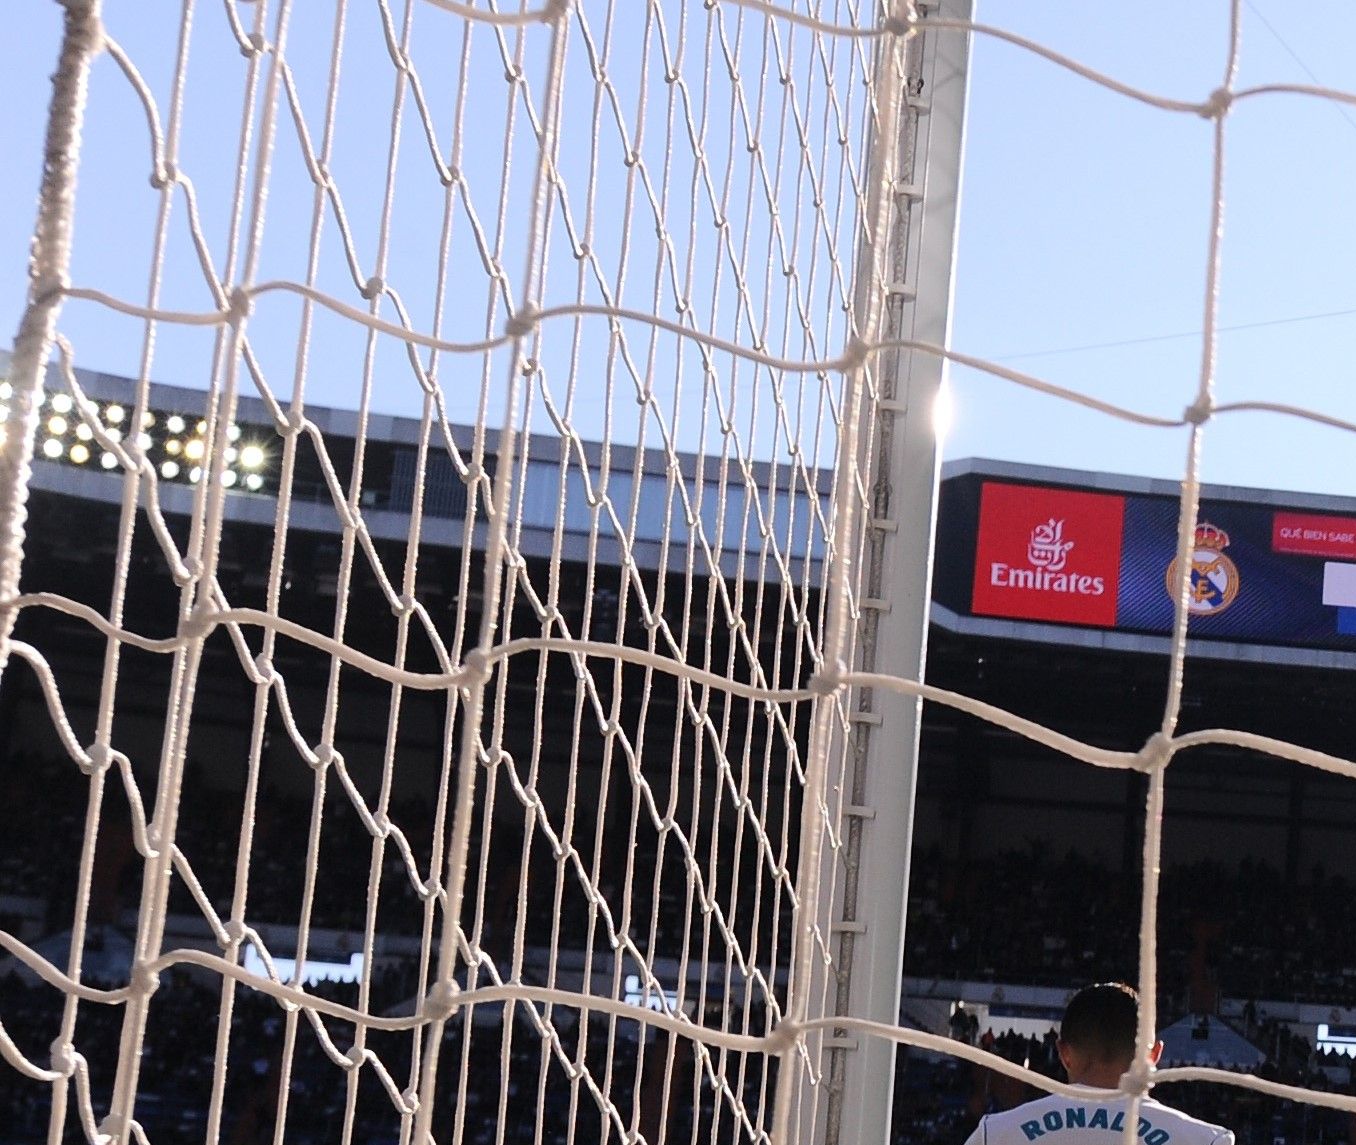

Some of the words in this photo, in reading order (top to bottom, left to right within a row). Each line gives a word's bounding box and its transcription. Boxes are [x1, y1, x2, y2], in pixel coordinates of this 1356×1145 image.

[1304, 529, 1327, 541] BIEN
[1328, 531, 1355, 544] SABE
[990, 562, 1105, 596] Emirates
